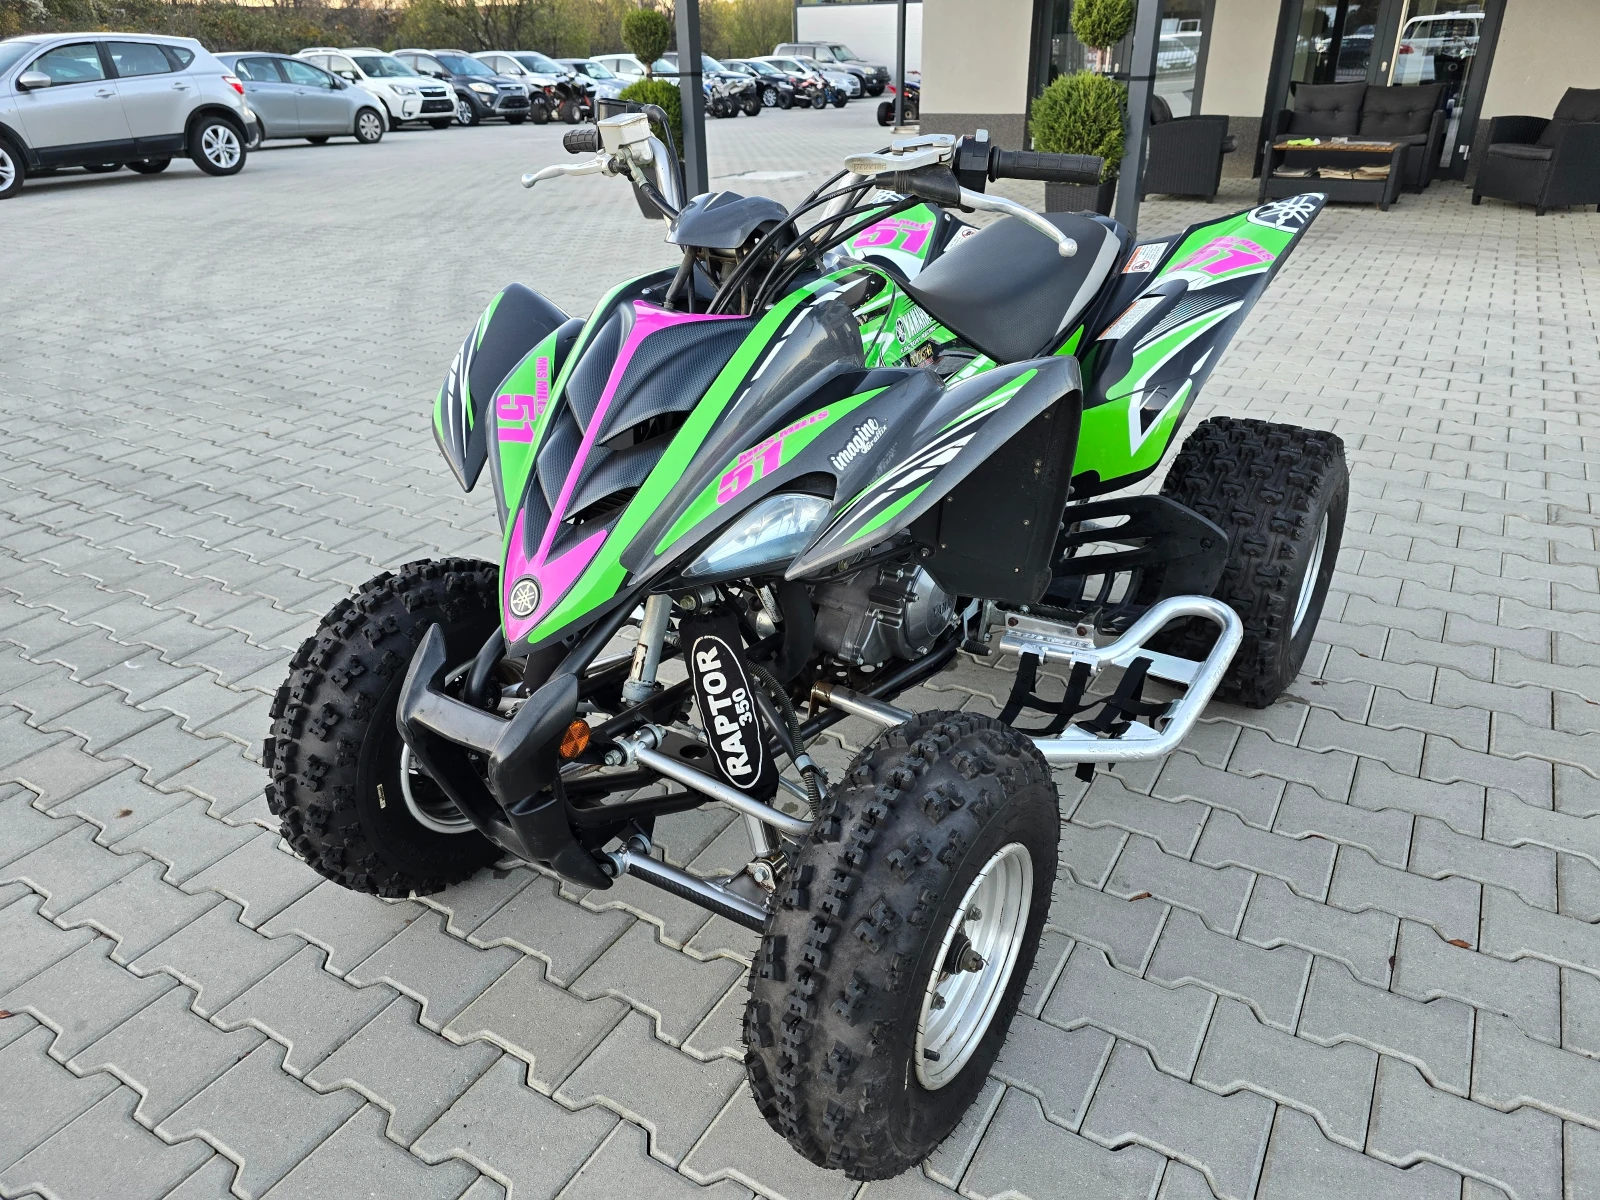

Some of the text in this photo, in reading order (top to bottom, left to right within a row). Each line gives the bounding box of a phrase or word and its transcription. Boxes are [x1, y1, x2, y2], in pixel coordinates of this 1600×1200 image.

[853, 163, 887, 171] PARKING
[852, 221, 934, 254] 51
[1237, 238, 1276, 261] MILLS
[901, 337, 921, 353] FACTORY
[535, 356, 549, 379] MRS
[496, 393, 536, 444] 51
[738, 410, 829, 465] MRS MILLS
[830, 418, 879, 471] imagine
[716, 438, 784, 505] 51
[696, 646, 753, 776] RAPTOR
[732, 687, 753, 727] 350
